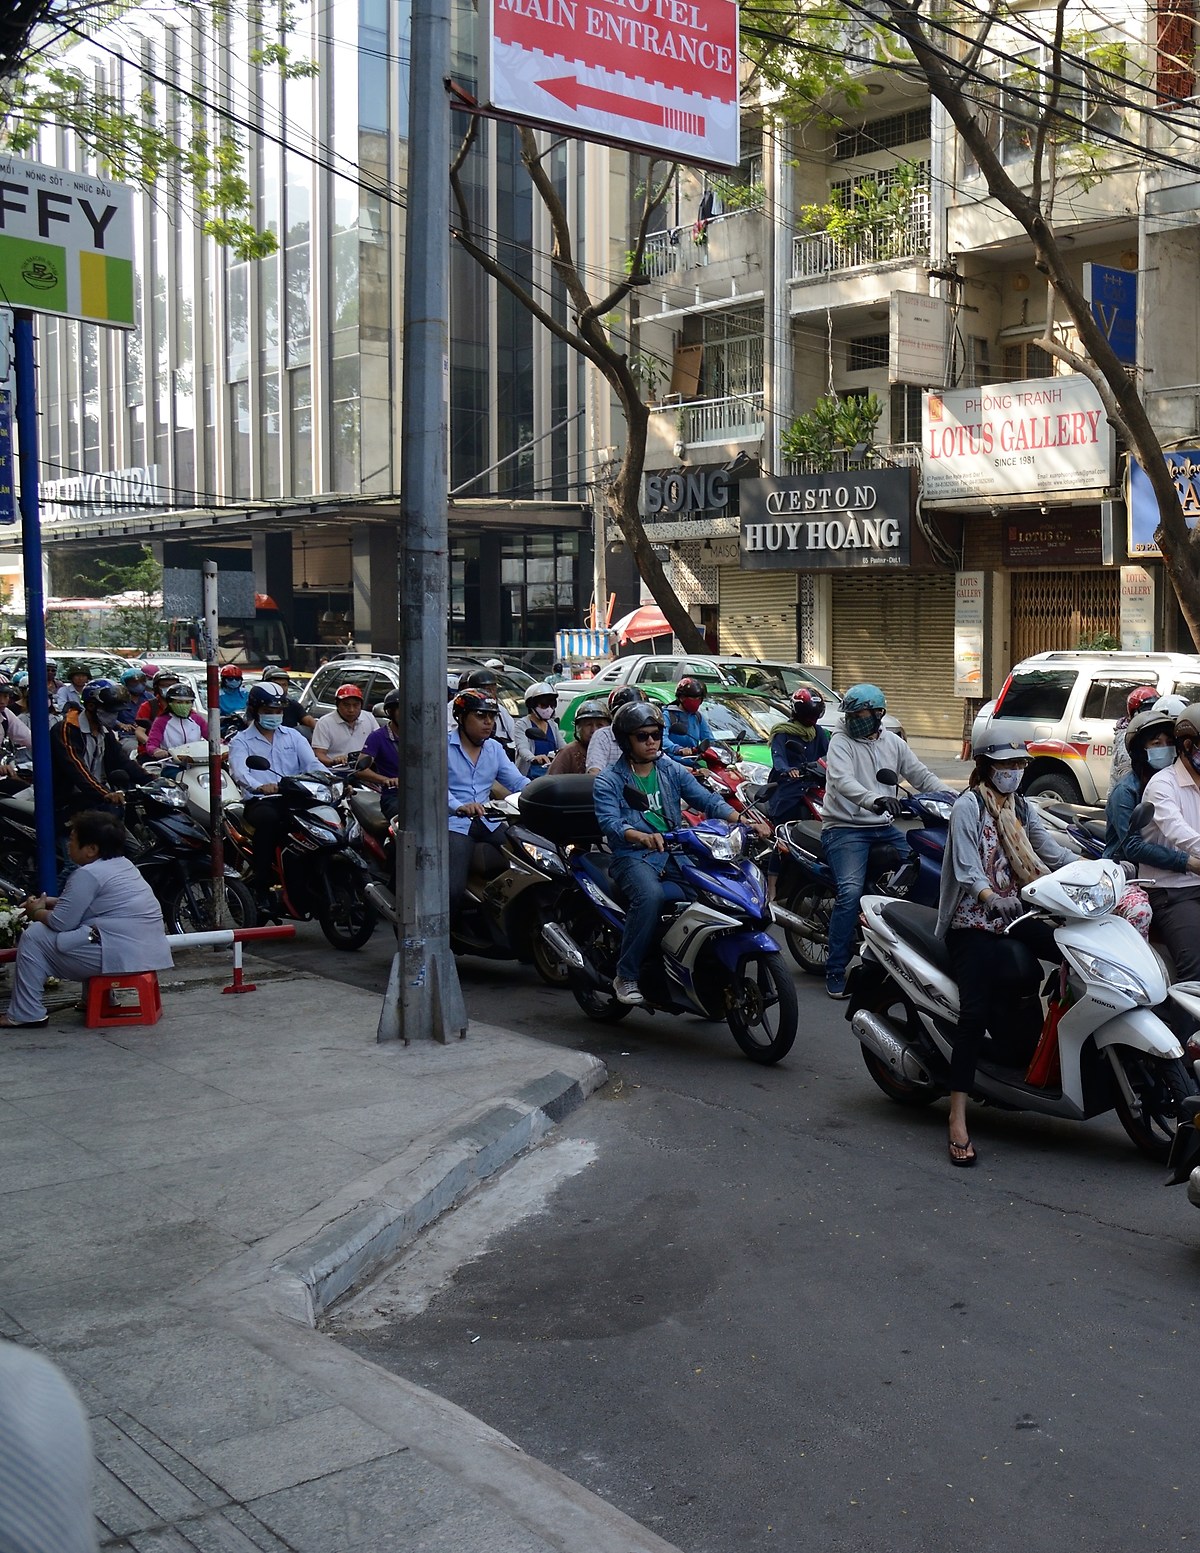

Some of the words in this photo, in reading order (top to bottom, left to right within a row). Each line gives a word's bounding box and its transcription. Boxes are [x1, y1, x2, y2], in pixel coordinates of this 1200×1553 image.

[609, 0, 708, 32] OTEL
[585, 6, 732, 75] ENTRANCE
[965, 394, 1012, 413] PHÒNG
[1015, 388, 1062, 407] TRANH
[929, 422, 994, 459] LOTUS
[1001, 410, 1102, 452] GALLERY
[994, 457, 1017, 467] SINCE
[1019, 455, 1036, 466] 1981
[91, 464, 163, 517] CENTRAL
[775, 485, 869, 511] VESTON
[745, 523, 802, 550] HUY
[806, 511, 901, 550] HOÀNG
[960, 577, 978, 586] LOTUS
[1122, 586, 1152, 595] GALLERY
[1126, 573, 1147, 583] LOTUS
[957, 589, 982, 598] GALLERY
[1092, 997, 1116, 1010] HONDA
